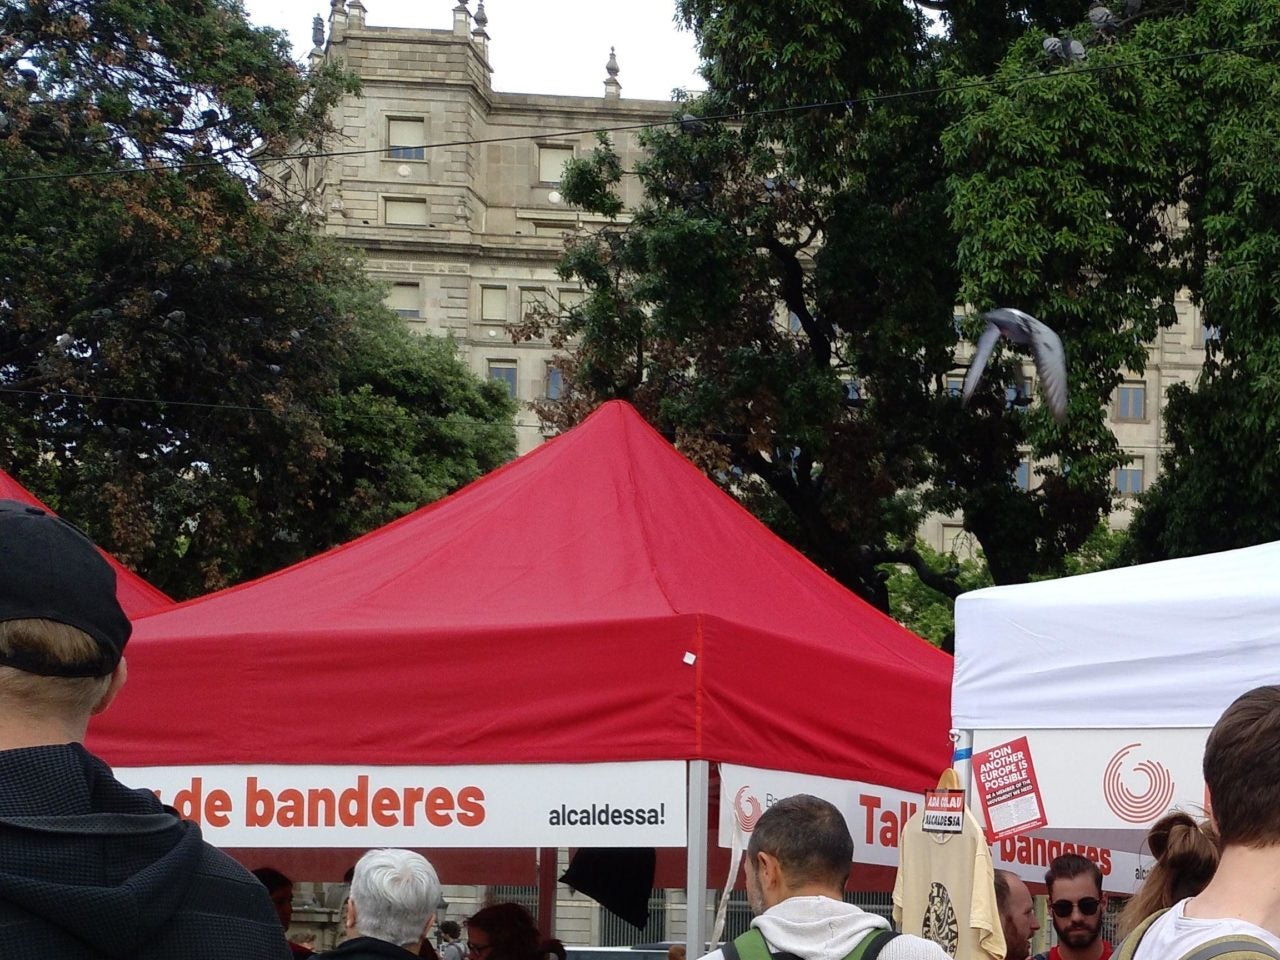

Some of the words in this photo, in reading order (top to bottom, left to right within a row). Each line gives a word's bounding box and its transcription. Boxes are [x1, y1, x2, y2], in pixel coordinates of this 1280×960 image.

[980, 751, 1025, 773] ANOTHER
[988, 745, 1012, 760] JOIN
[980, 763, 1017, 782] EUROPE
[1019, 760, 1028, 770] IS
[984, 770, 1028, 790] POSSIBLE
[173, 777, 232, 827] de
[245, 775, 486, 827] banderes
[927, 796, 940, 808] ADA
[940, 795, 962, 808] COLAU
[549, 803, 665, 826] alcaldessa!
[925, 814, 961, 827] ALCALDESSA
